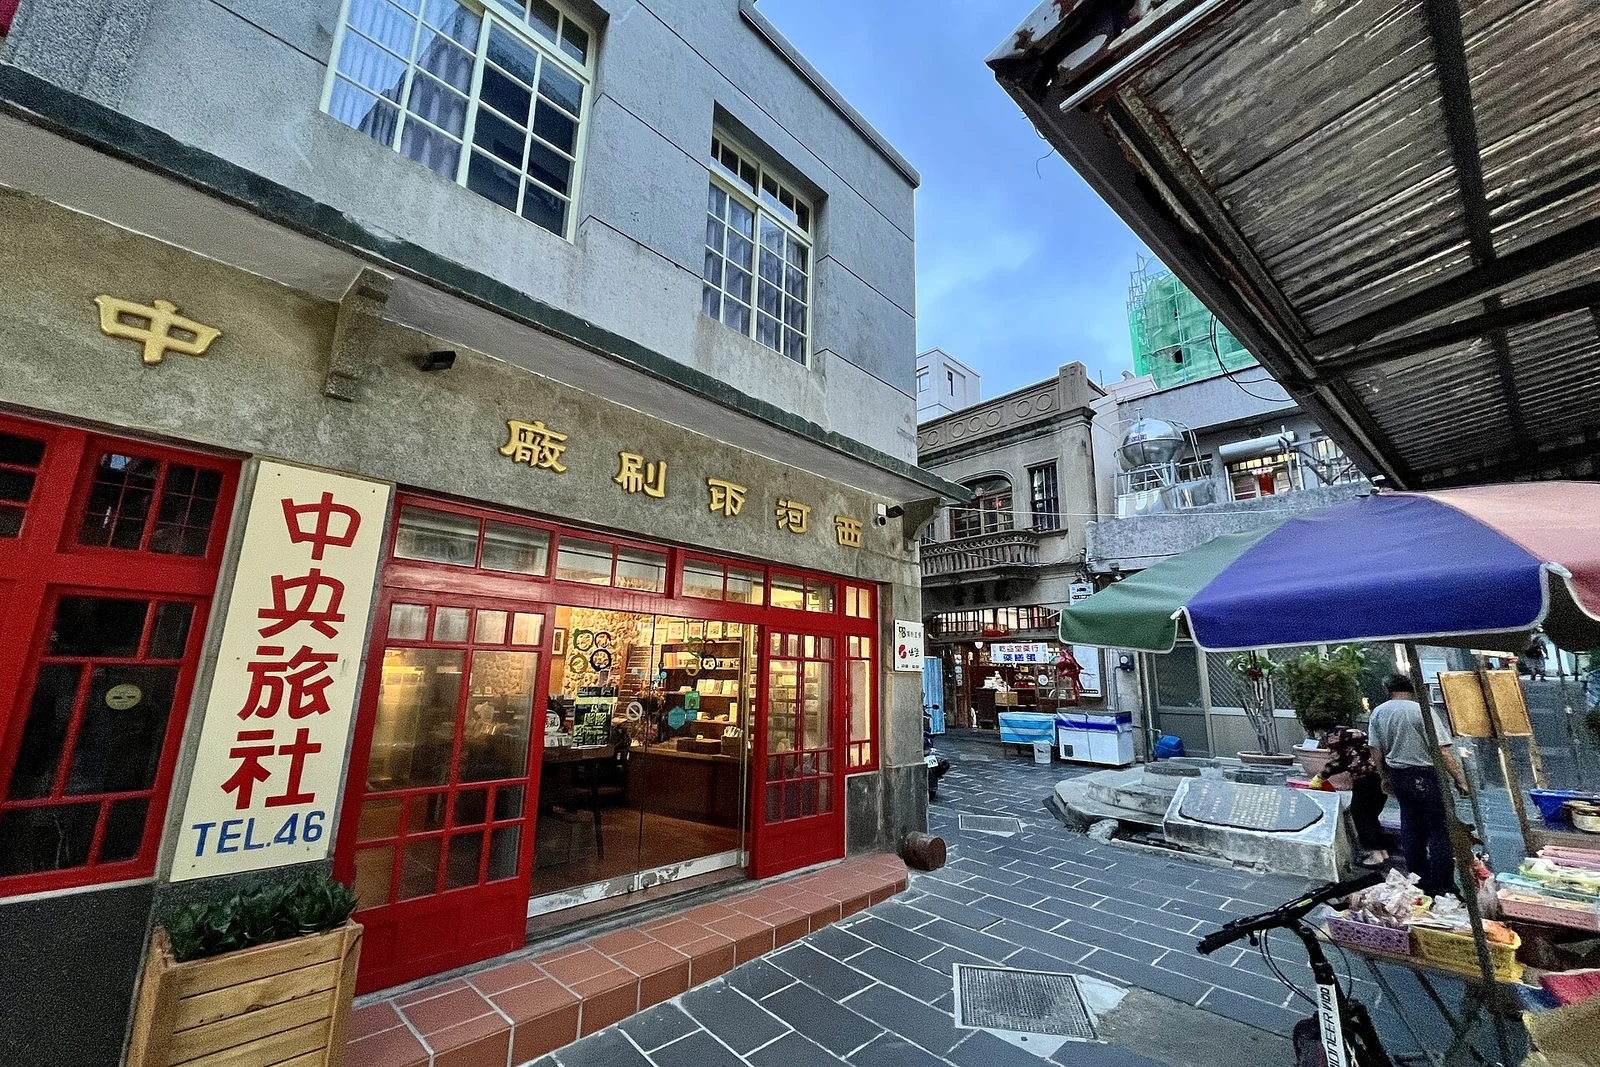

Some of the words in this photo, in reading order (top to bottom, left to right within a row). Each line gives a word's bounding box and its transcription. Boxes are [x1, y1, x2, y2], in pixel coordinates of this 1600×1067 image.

[94, 294, 221, 363] 中
[220, 491, 362, 810] 中央旅社
[191, 810, 326, 858] TEL.46
[1322, 1012, 1340, 1067] IONEER
